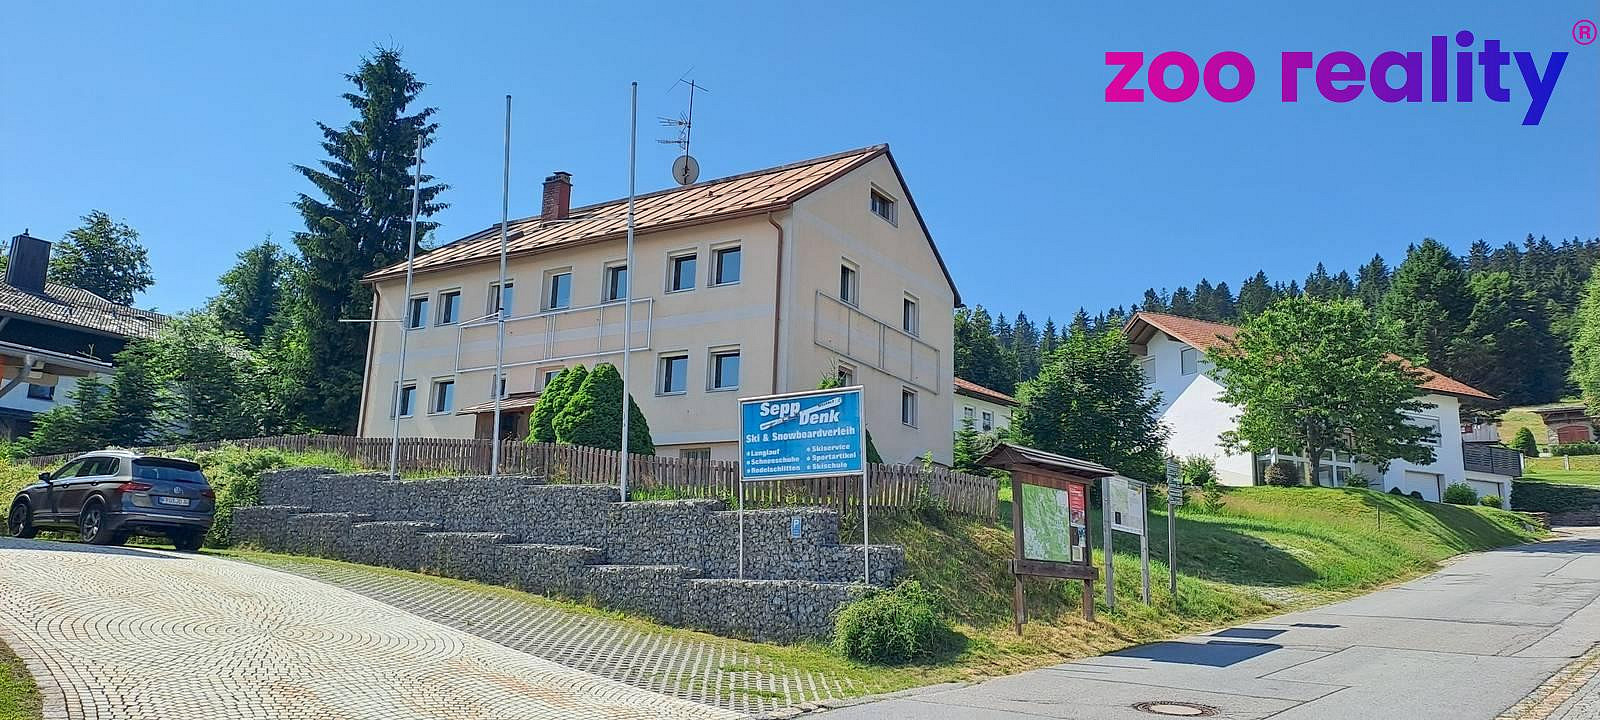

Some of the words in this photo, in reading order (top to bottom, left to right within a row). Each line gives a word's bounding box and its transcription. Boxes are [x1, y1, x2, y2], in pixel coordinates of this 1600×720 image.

[760, 401, 800, 417] Sepp
[799, 410, 840, 425] Denk
[746, 433, 760, 443] Ski
[762, 433, 769, 442] &
[772, 426, 856, 441] Snowboardverleih
[751, 448, 780, 457] Langlauf
[812, 444, 850, 452] Skiservice
[812, 452, 856, 461] Sportartikel
[812, 462, 848, 470] Skischule
